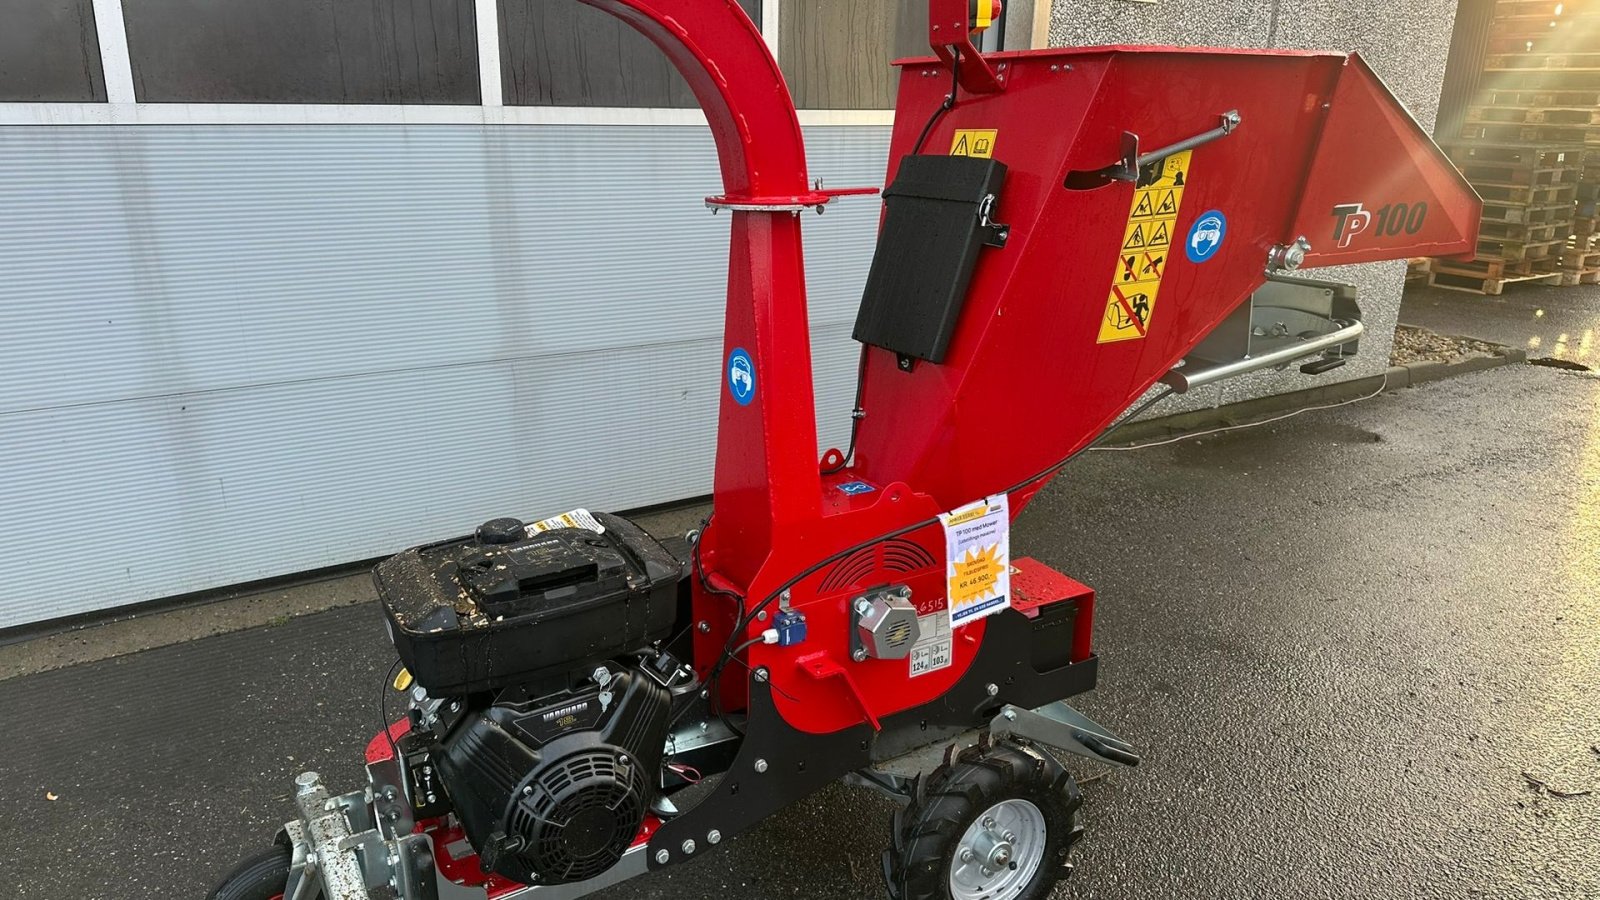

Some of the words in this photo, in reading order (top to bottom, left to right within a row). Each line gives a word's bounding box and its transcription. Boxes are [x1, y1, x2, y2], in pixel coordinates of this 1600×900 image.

[1332, 202, 1371, 248] TP
[1375, 201, 1427, 237] 100
[956, 529, 962, 537] TP
[963, 527, 971, 535] 100
[972, 524, 982, 532] med
[912, 660, 924, 671] 124
[932, 656, 943, 666] 103
[543, 702, 588, 722] VANGUARD
